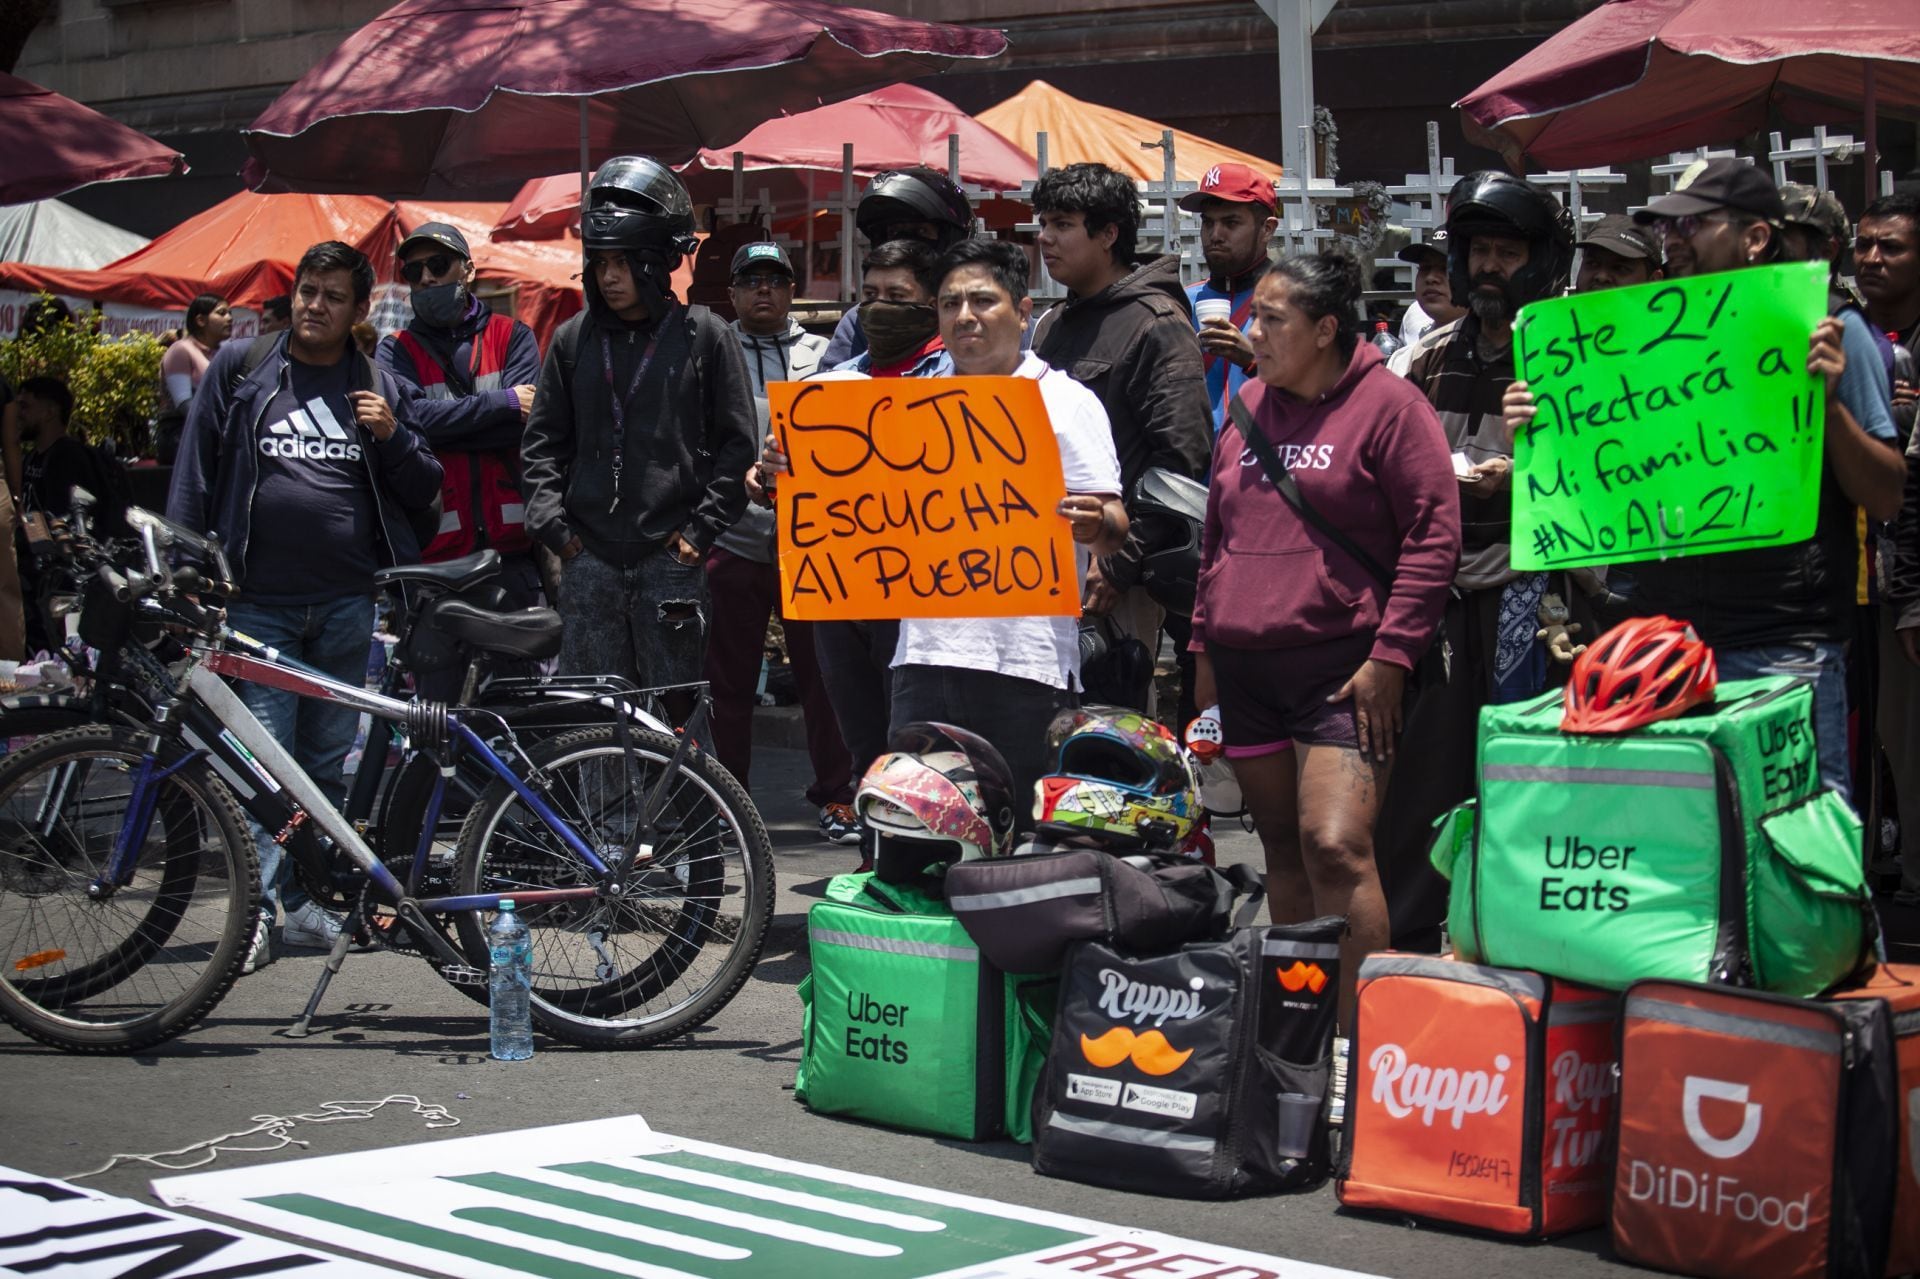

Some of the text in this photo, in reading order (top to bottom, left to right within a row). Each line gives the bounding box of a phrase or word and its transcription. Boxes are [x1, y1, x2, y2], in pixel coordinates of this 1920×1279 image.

[1521, 282, 1737, 385] Este 2%
[1524, 347, 1792, 447] Afectará a
[259, 434, 362, 461] adidas
[777, 384, 1026, 477] ¡SCJN
[1239, 443, 1335, 470] ESS
[1527, 458, 1581, 502] Mi
[791, 478, 1039, 548] ESCUCHA
[1756, 718, 1809, 758] Uber
[1762, 757, 1810, 800] Eats
[1545, 836, 1637, 871] Uber
[1540, 877, 1631, 912] Eats
[847, 990, 910, 1028] Uber
[1098, 968, 1206, 1027] Rappi
[846, 1027, 909, 1065] Eats
[1080, 1087, 1113, 1099] App Store
[1369, 1043, 1511, 1129] Rappi
[1552, 1050, 1614, 1113] Rap
[1140, 1097, 1192, 1113] Google Play
[1629, 1159, 1810, 1231] DiDi Food
